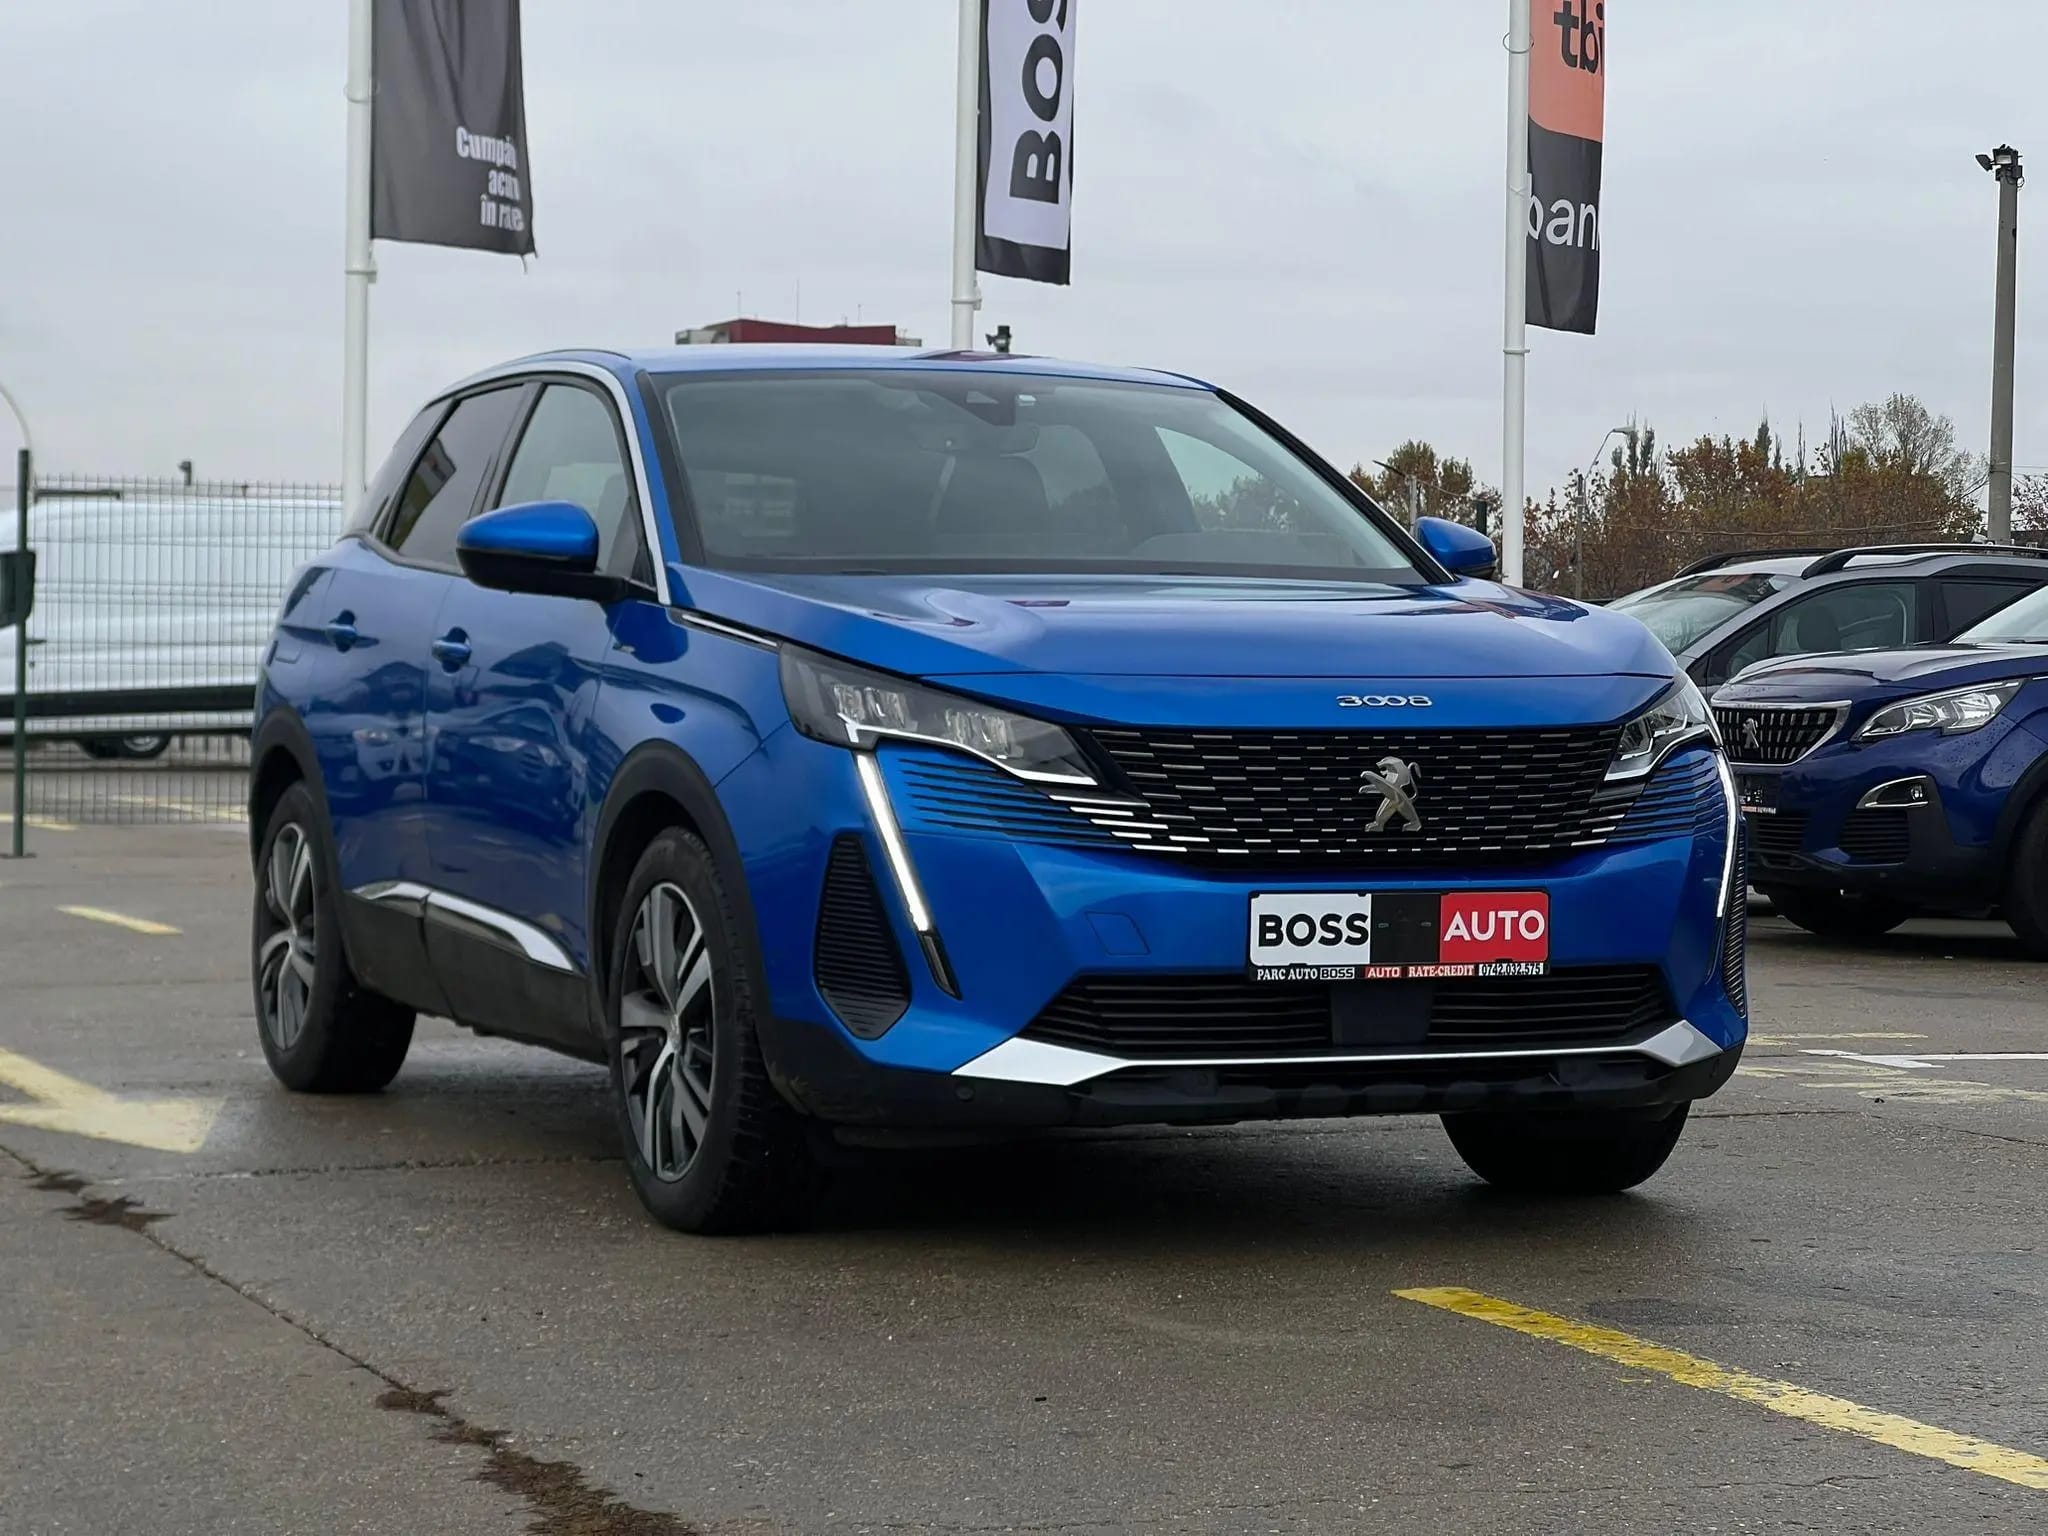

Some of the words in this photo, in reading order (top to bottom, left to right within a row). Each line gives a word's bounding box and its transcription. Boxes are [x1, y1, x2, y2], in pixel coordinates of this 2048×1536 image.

[1527, 173, 1599, 251] ban
[1336, 695, 1433, 707] 3008
[1258, 913, 1370, 947] BOSS
[1443, 910, 1545, 941] AUTO
[1256, 968, 1286, 981] PARC
[1288, 967, 1318, 980] AUTO
[1321, 967, 1354, 979] BOSS
[1367, 967, 1400, 978] AUTO
